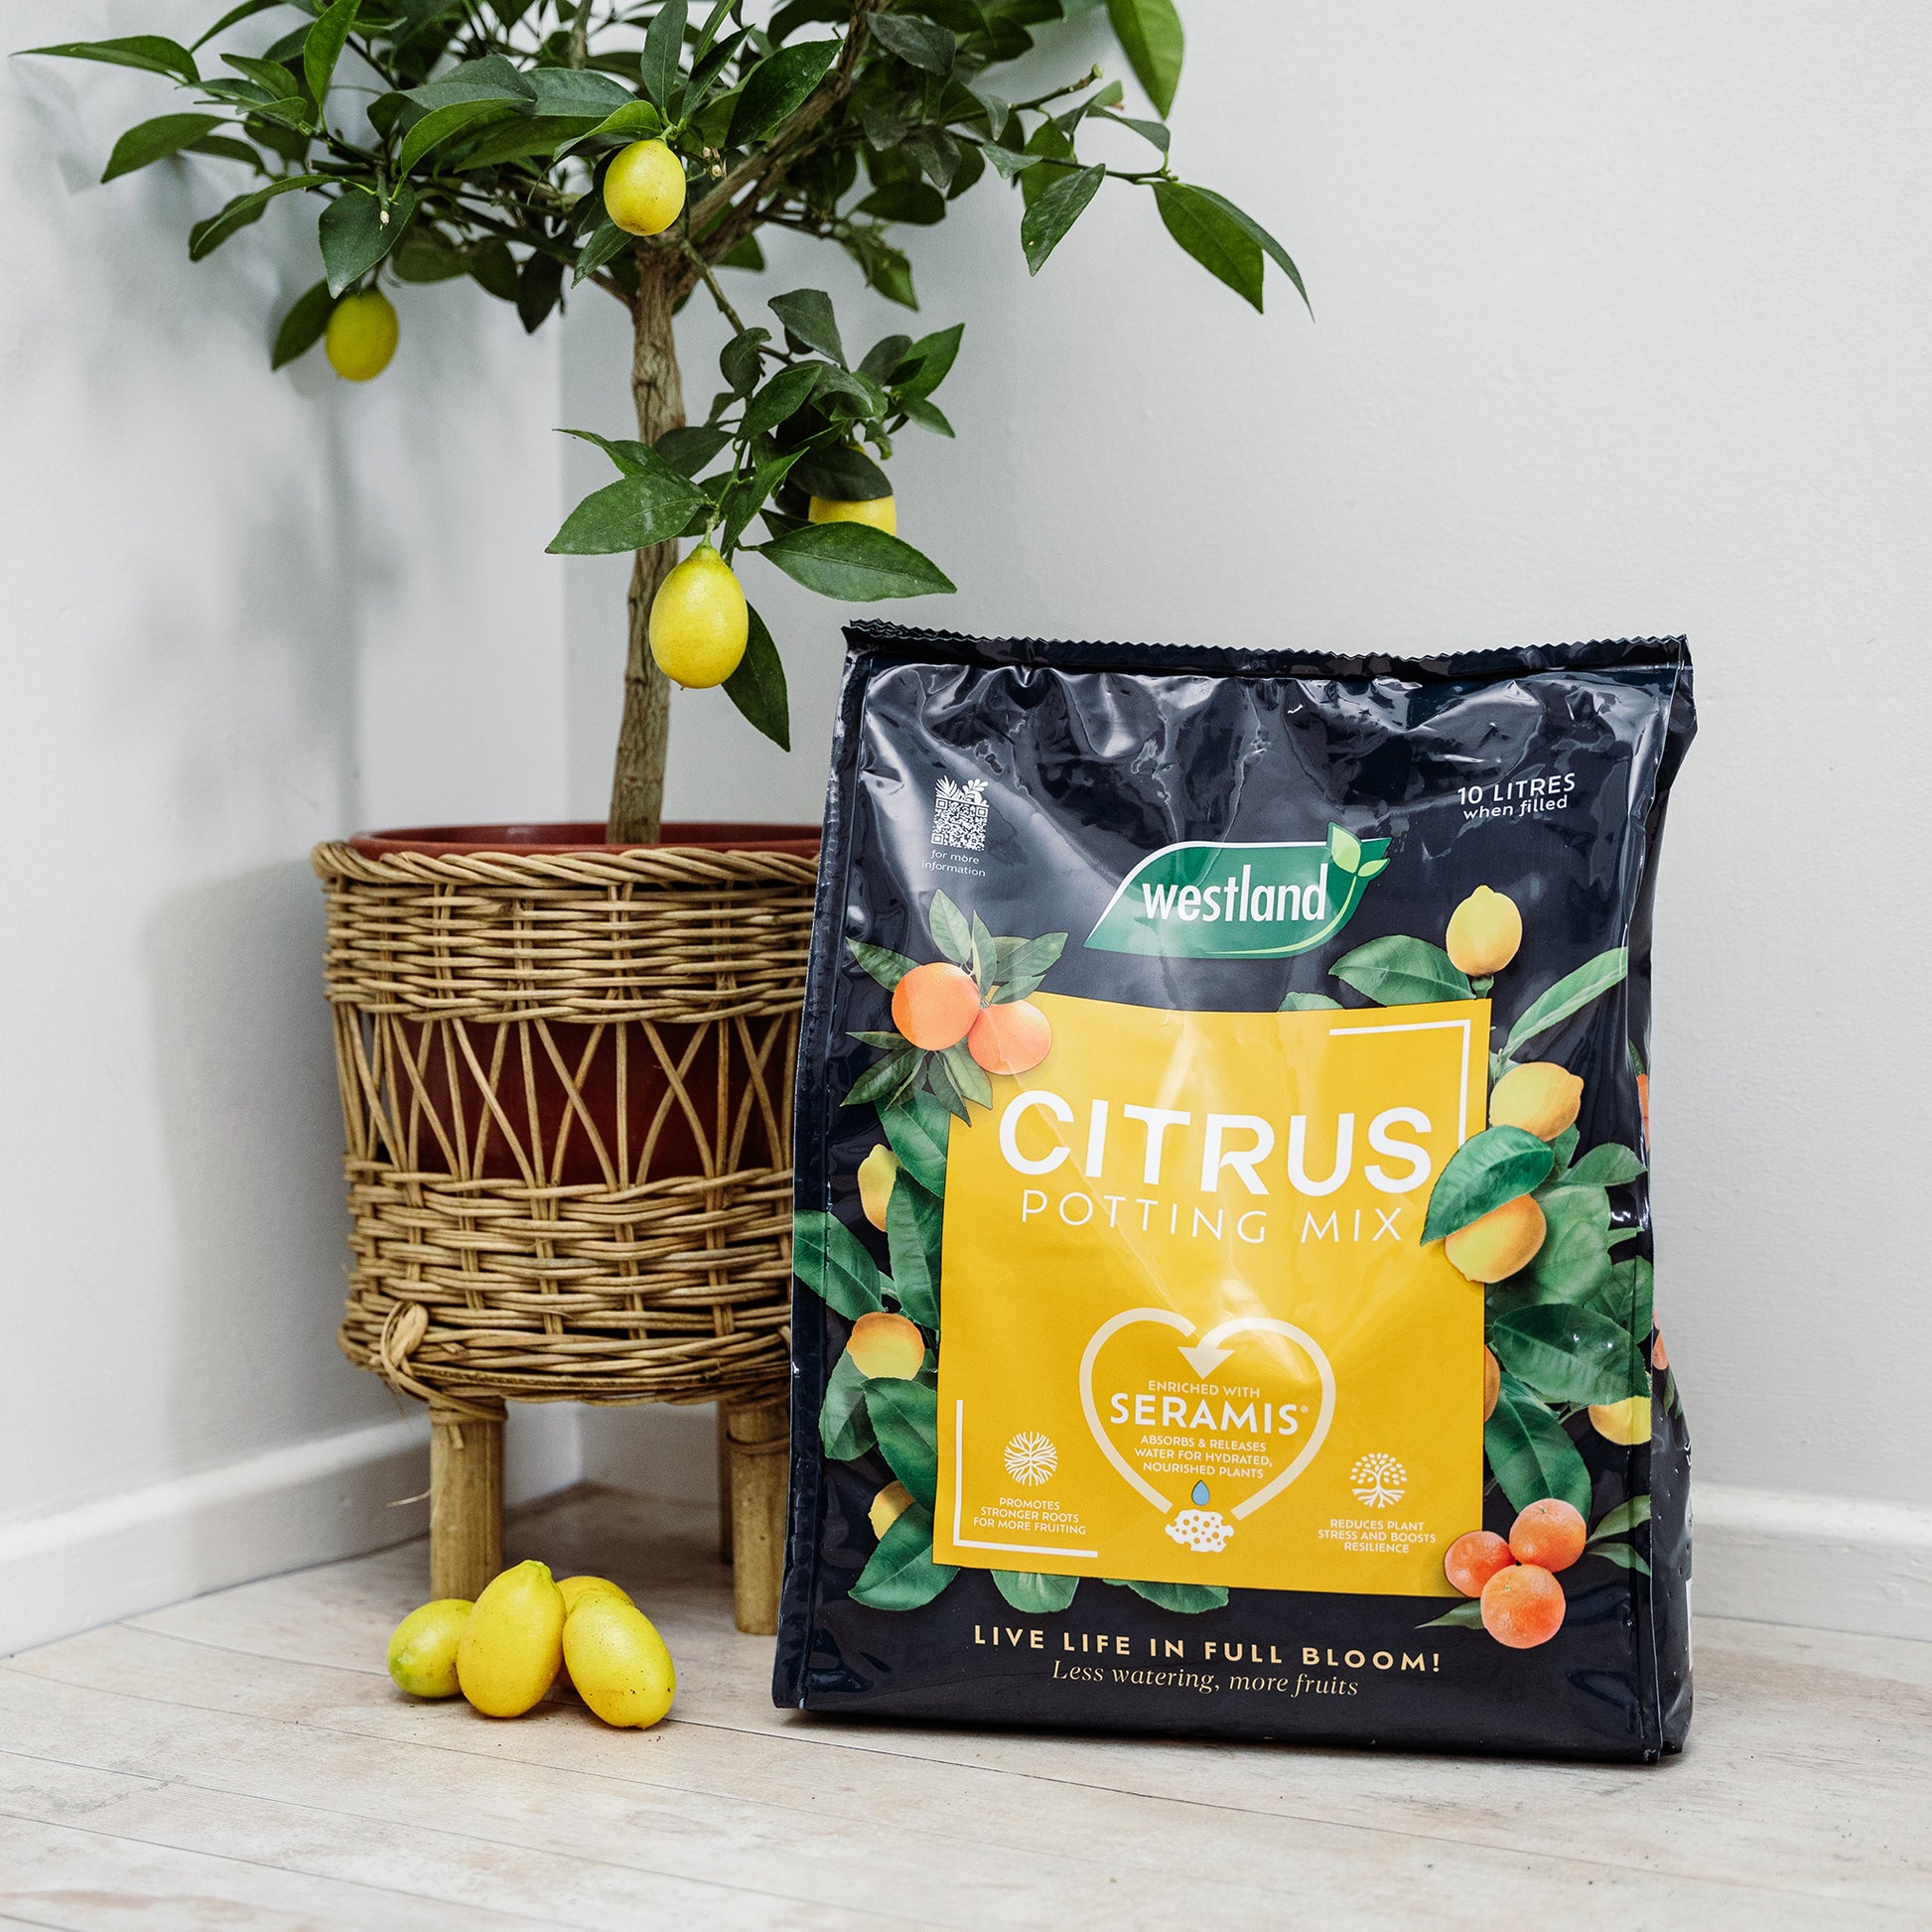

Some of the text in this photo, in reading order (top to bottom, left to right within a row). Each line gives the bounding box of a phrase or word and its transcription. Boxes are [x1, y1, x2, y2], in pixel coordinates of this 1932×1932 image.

[1457, 772, 1576, 805] 10 LITRES
[1463, 794, 1568, 820] when filled
[930, 849, 980, 865] for more
[921, 860, 986, 878] information
[1142, 863, 1328, 922] westland
[999, 1089, 1433, 1197] CITRUS
[1021, 1188, 1403, 1244] POTTING MIX
[1148, 1380, 1260, 1399] ENRICHED WITH
[1141, 1435, 1267, 1452] ABSORBS & RELEASES
[1135, 1448, 1273, 1467] WATER FOR HYDRATED,
[1143, 1461, 1264, 1479] NOURISHED PLANTS
[999, 1497, 1060, 1511] PROMOTES
[981, 1506, 1079, 1524] STRONGER ROOTS
[973, 1517, 1086, 1535] FOR MORE FRUITING
[1330, 1518, 1425, 1532] REDUCES PLANT
[1317, 1529, 1437, 1544] STRESS AND BOOSTS
[1343, 1541, 1410, 1554] RESILIENCE
[974, 1624, 1441, 1673] LIVE LIFE IN FULL BLOOM!
[1052, 1659, 1359, 1698] Less watering, more fruits
